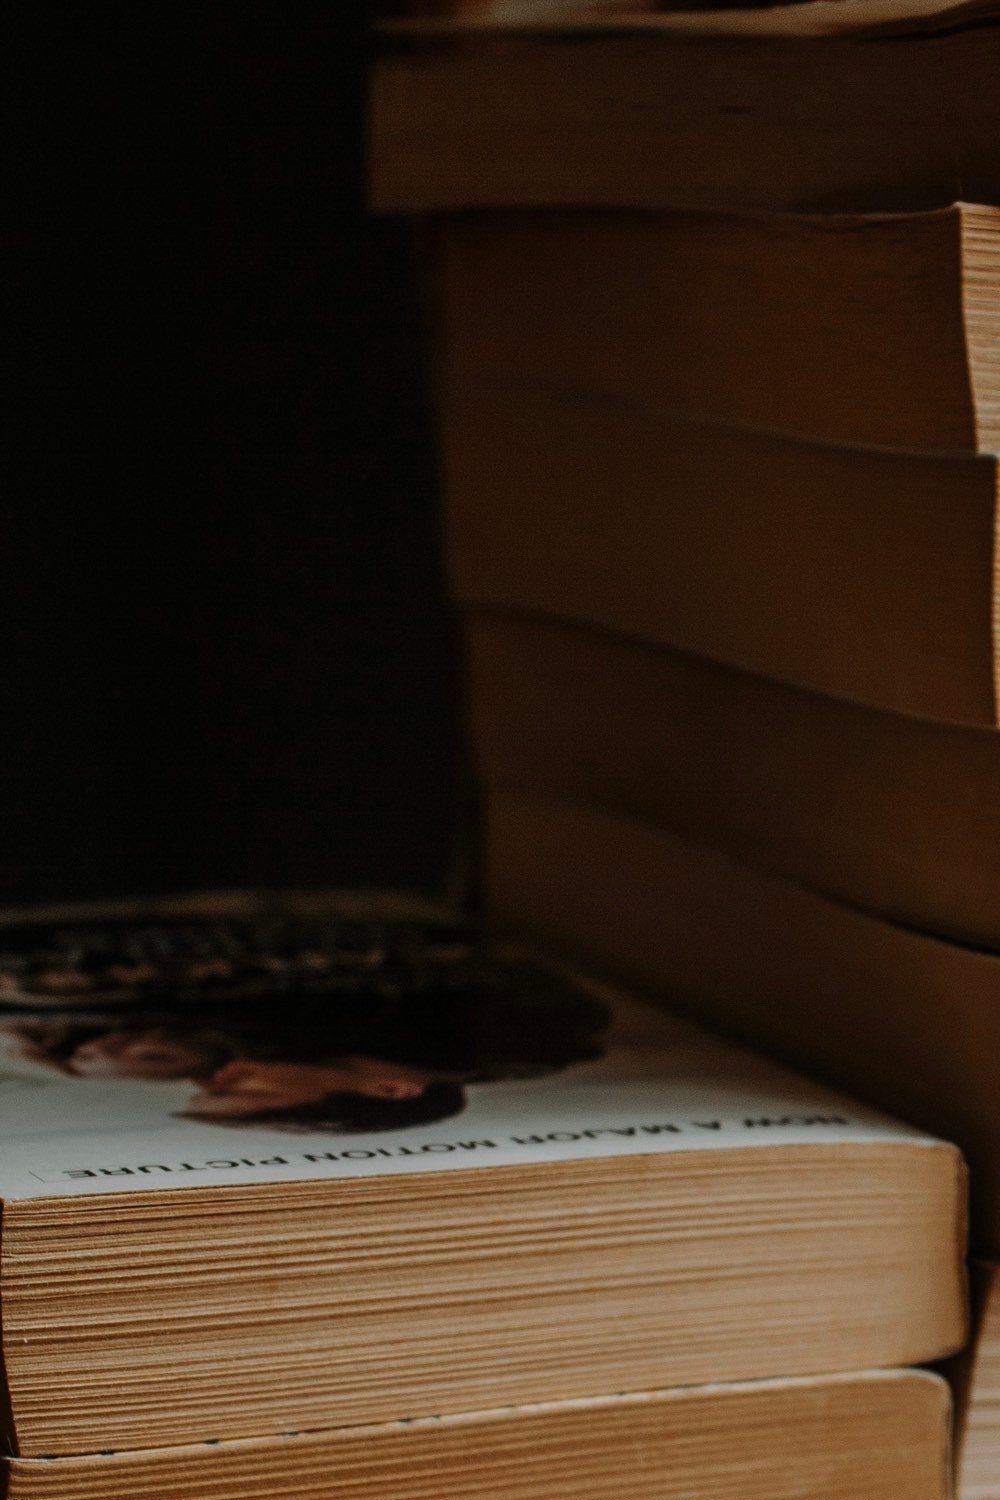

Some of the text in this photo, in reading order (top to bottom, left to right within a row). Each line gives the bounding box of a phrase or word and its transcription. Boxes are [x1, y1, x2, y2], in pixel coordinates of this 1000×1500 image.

[61, 1114, 848, 1179] NOW A MAJOR MOTION PICTURE
